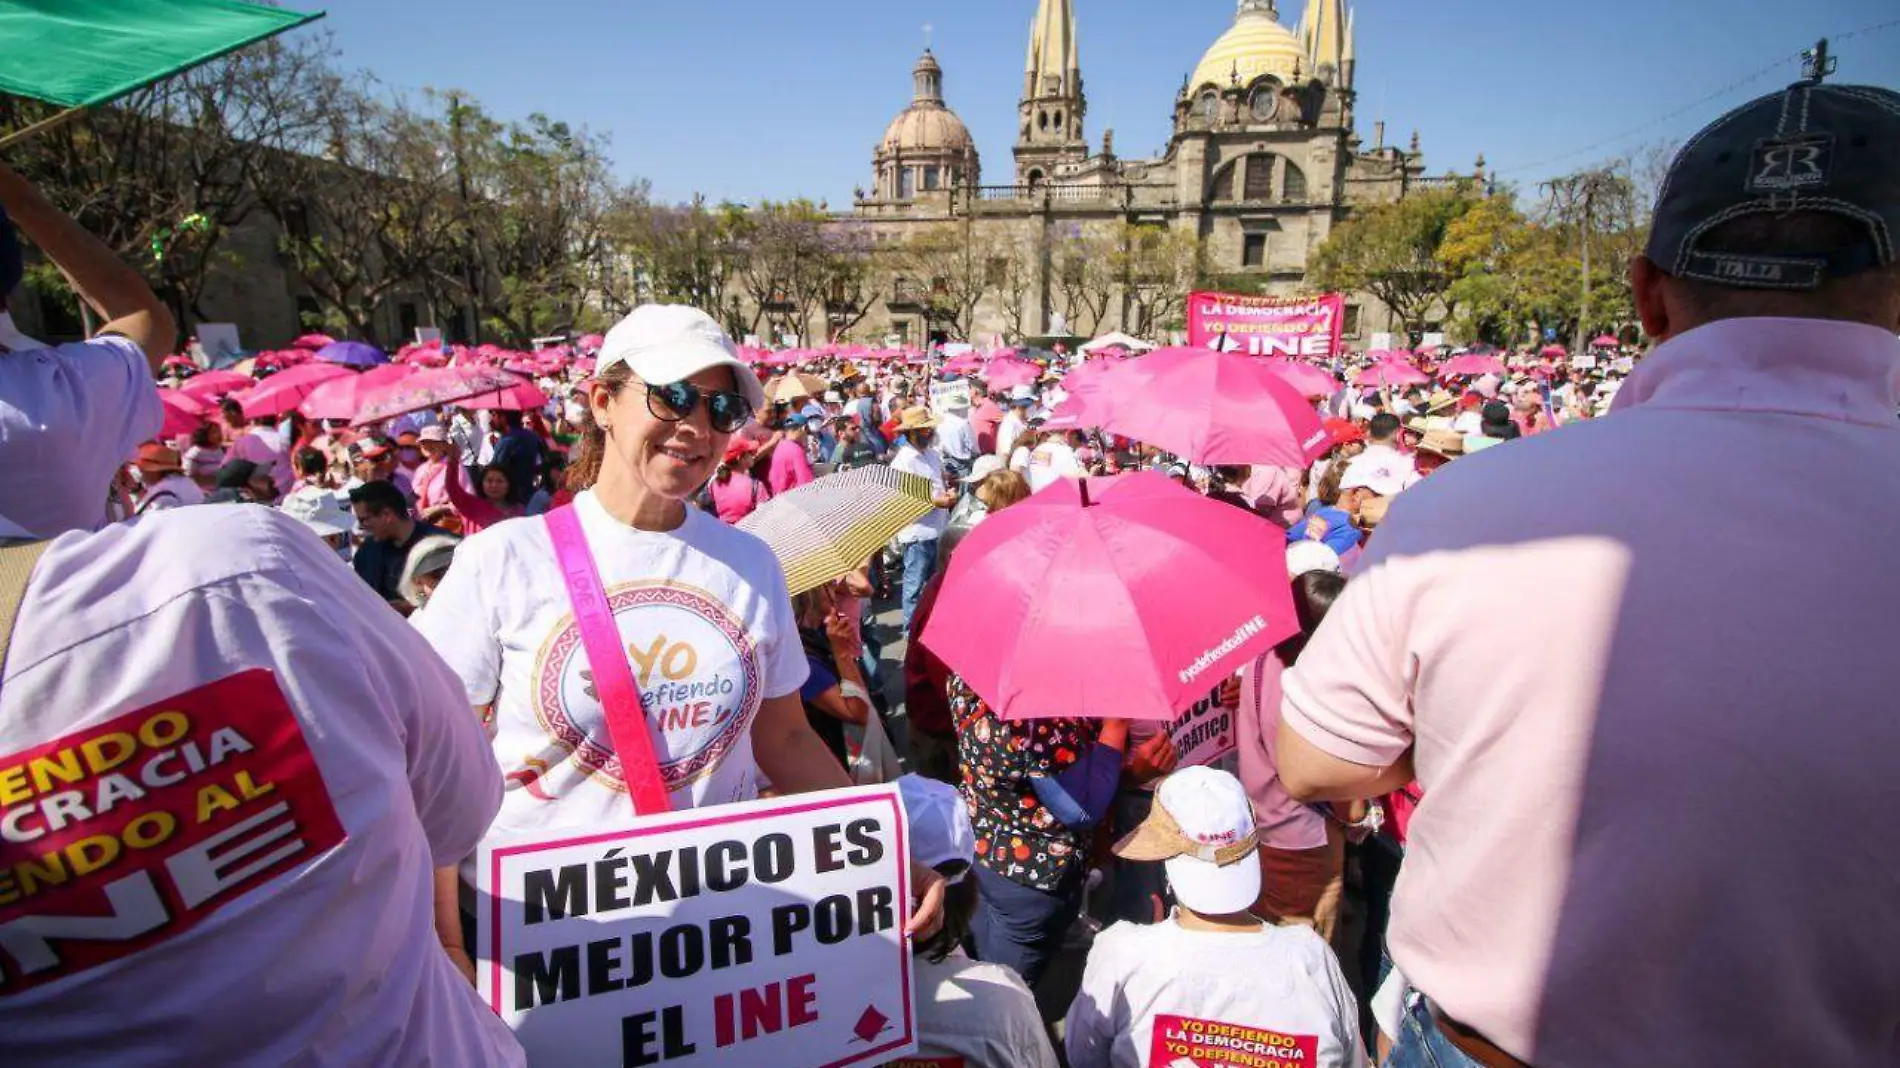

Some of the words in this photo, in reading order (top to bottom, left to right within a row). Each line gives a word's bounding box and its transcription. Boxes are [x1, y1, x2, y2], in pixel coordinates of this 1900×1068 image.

[1713, 259, 1783, 280] ITALIA
[1202, 304, 1223, 315] LA
[1226, 304, 1331, 316] DEMOCRACIA
[1203, 321, 1225, 333] YO
[1227, 321, 1308, 334] DEFIENDO
[1248, 335, 1332, 356] INE
[628, 634, 698, 689] YO
[641, 673, 734, 708] efiendo
[197, 769, 275, 824] AL
[523, 831, 796, 925] MÉXICO
[812, 818, 884, 874] ES
[0, 800, 305, 983] NE
[514, 914, 753, 1012] MEJOR
[772, 885, 894, 956] POR
[622, 1005, 696, 1068] EL
[714, 973, 819, 1048] INE
[1181, 1019, 1204, 1032] YO
[1207, 1023, 1296, 1048] DEFIENDO
[1165, 1041, 1189, 1056] YO
[1192, 1047, 1281, 1068] DEFIENDO
[1166, 1028, 1188, 1040] LA
[1191, 1034, 1305, 1059] DEMOCRACIA
